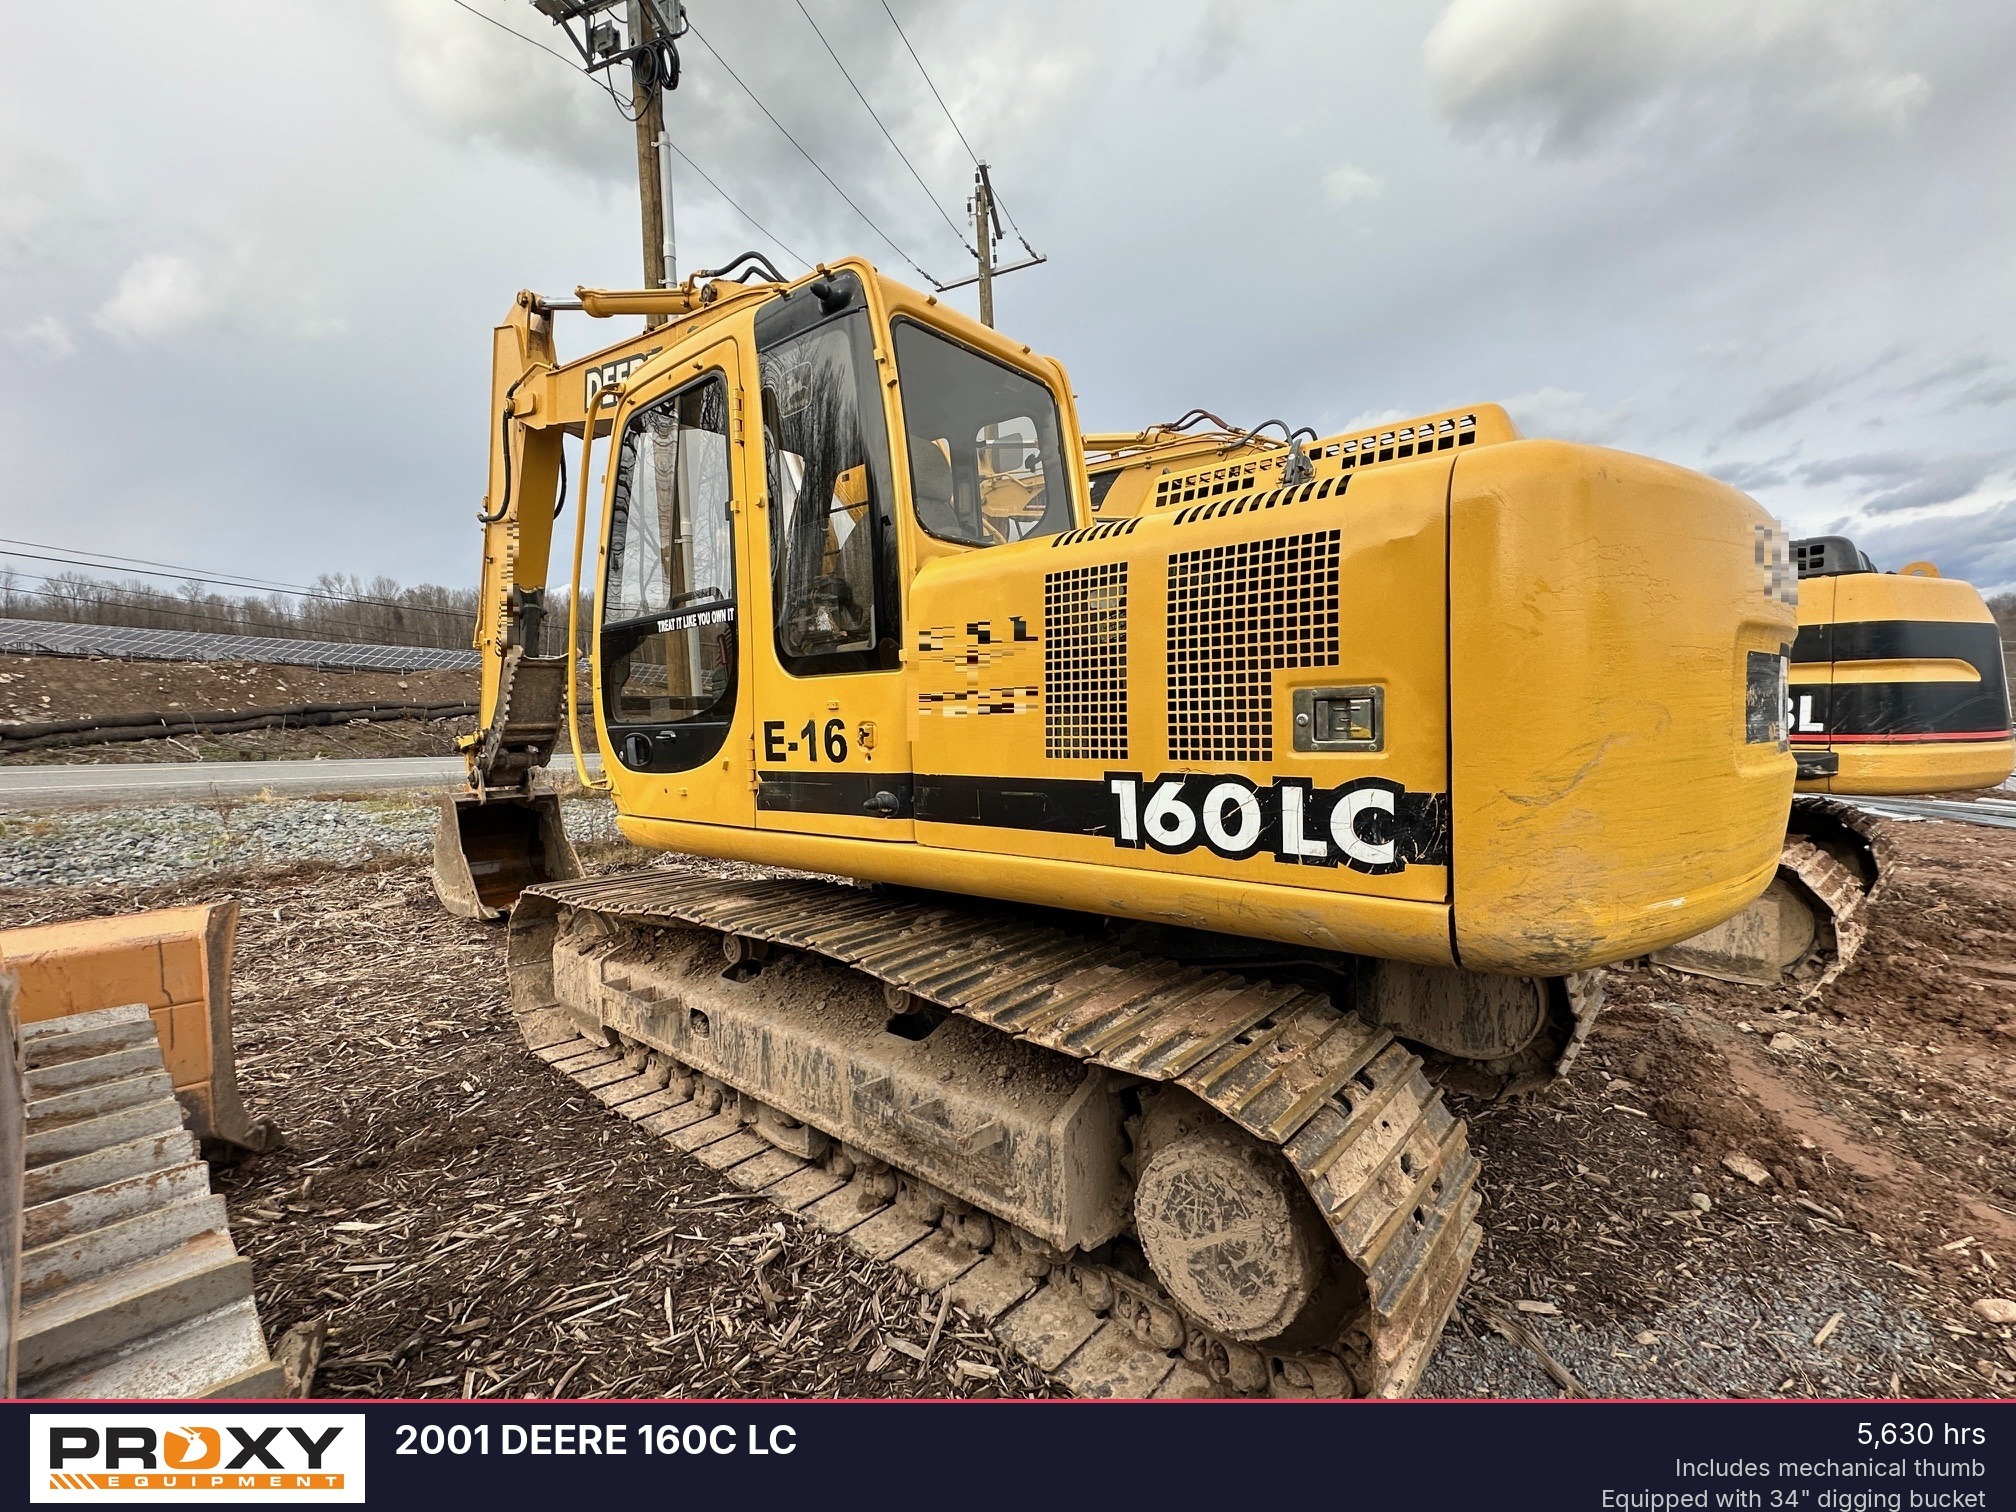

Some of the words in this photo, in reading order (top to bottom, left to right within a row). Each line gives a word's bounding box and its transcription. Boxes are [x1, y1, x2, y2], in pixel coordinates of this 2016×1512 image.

[657, 618, 675, 633] TREAT
[676, 616, 682, 630] IT
[683, 614, 697, 628] LIKE
[698, 611, 711, 626] YOU
[711, 609, 726, 623] OWN
[727, 607, 734, 621] IT
[763, 718, 848, 763] E-16
[1111, 779, 1262, 852] 160
[1281, 786, 1395, 864] LC
